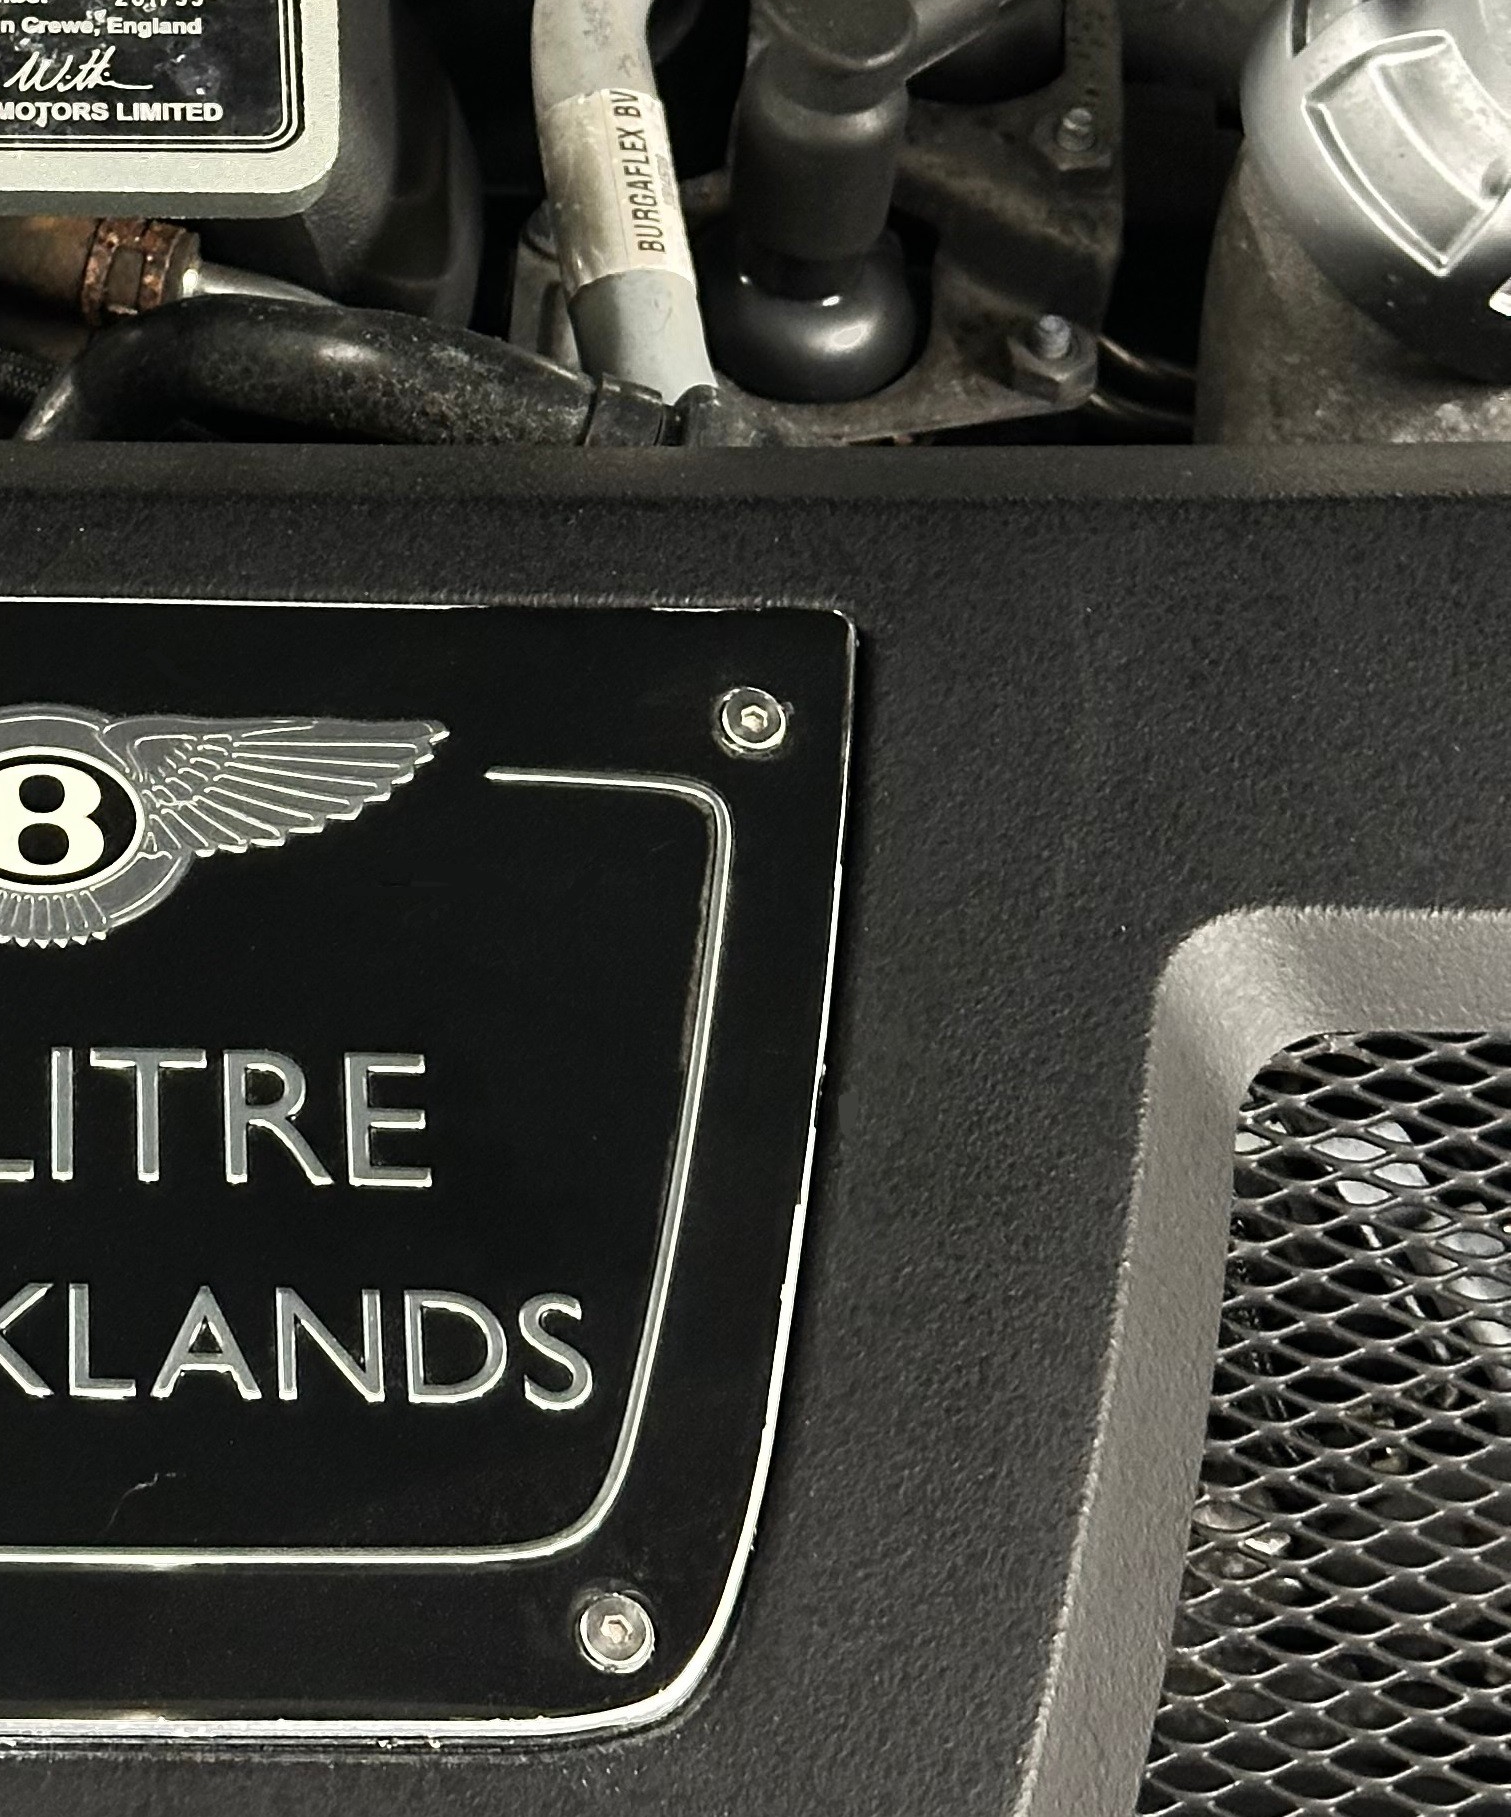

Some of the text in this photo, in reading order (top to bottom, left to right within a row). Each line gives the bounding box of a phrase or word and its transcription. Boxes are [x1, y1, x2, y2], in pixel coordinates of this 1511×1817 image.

[21, 16, 101, 37] Crewe,
[106, 16, 202, 38] England
[116, 103, 224, 122] LIMITED
[609, 90, 642, 119] BV
[616, 127, 666, 254] BURGAFLEX
